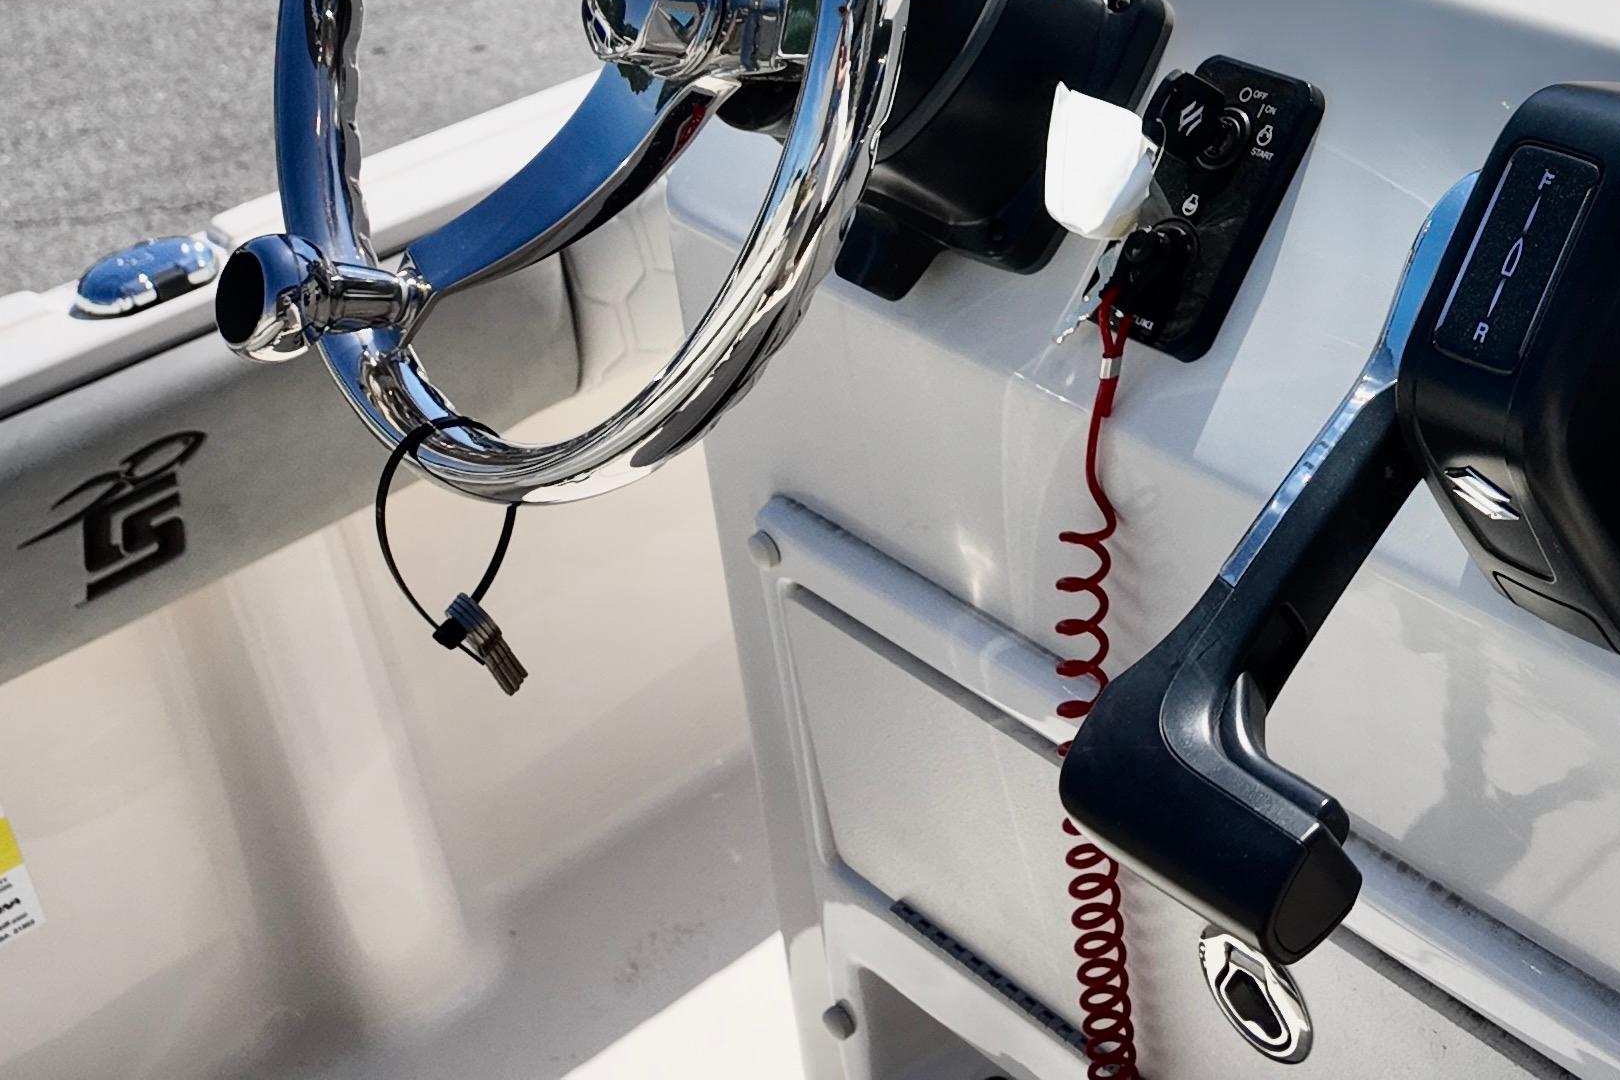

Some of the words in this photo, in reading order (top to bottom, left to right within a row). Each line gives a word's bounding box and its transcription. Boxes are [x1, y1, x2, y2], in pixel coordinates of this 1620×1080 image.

[1253, 89, 1269, 100] OFF
[1264, 104, 1278, 116] ON
[1250, 146, 1275, 161] START
[1537, 169, 1556, 191] F
[1472, 321, 1490, 344] R
